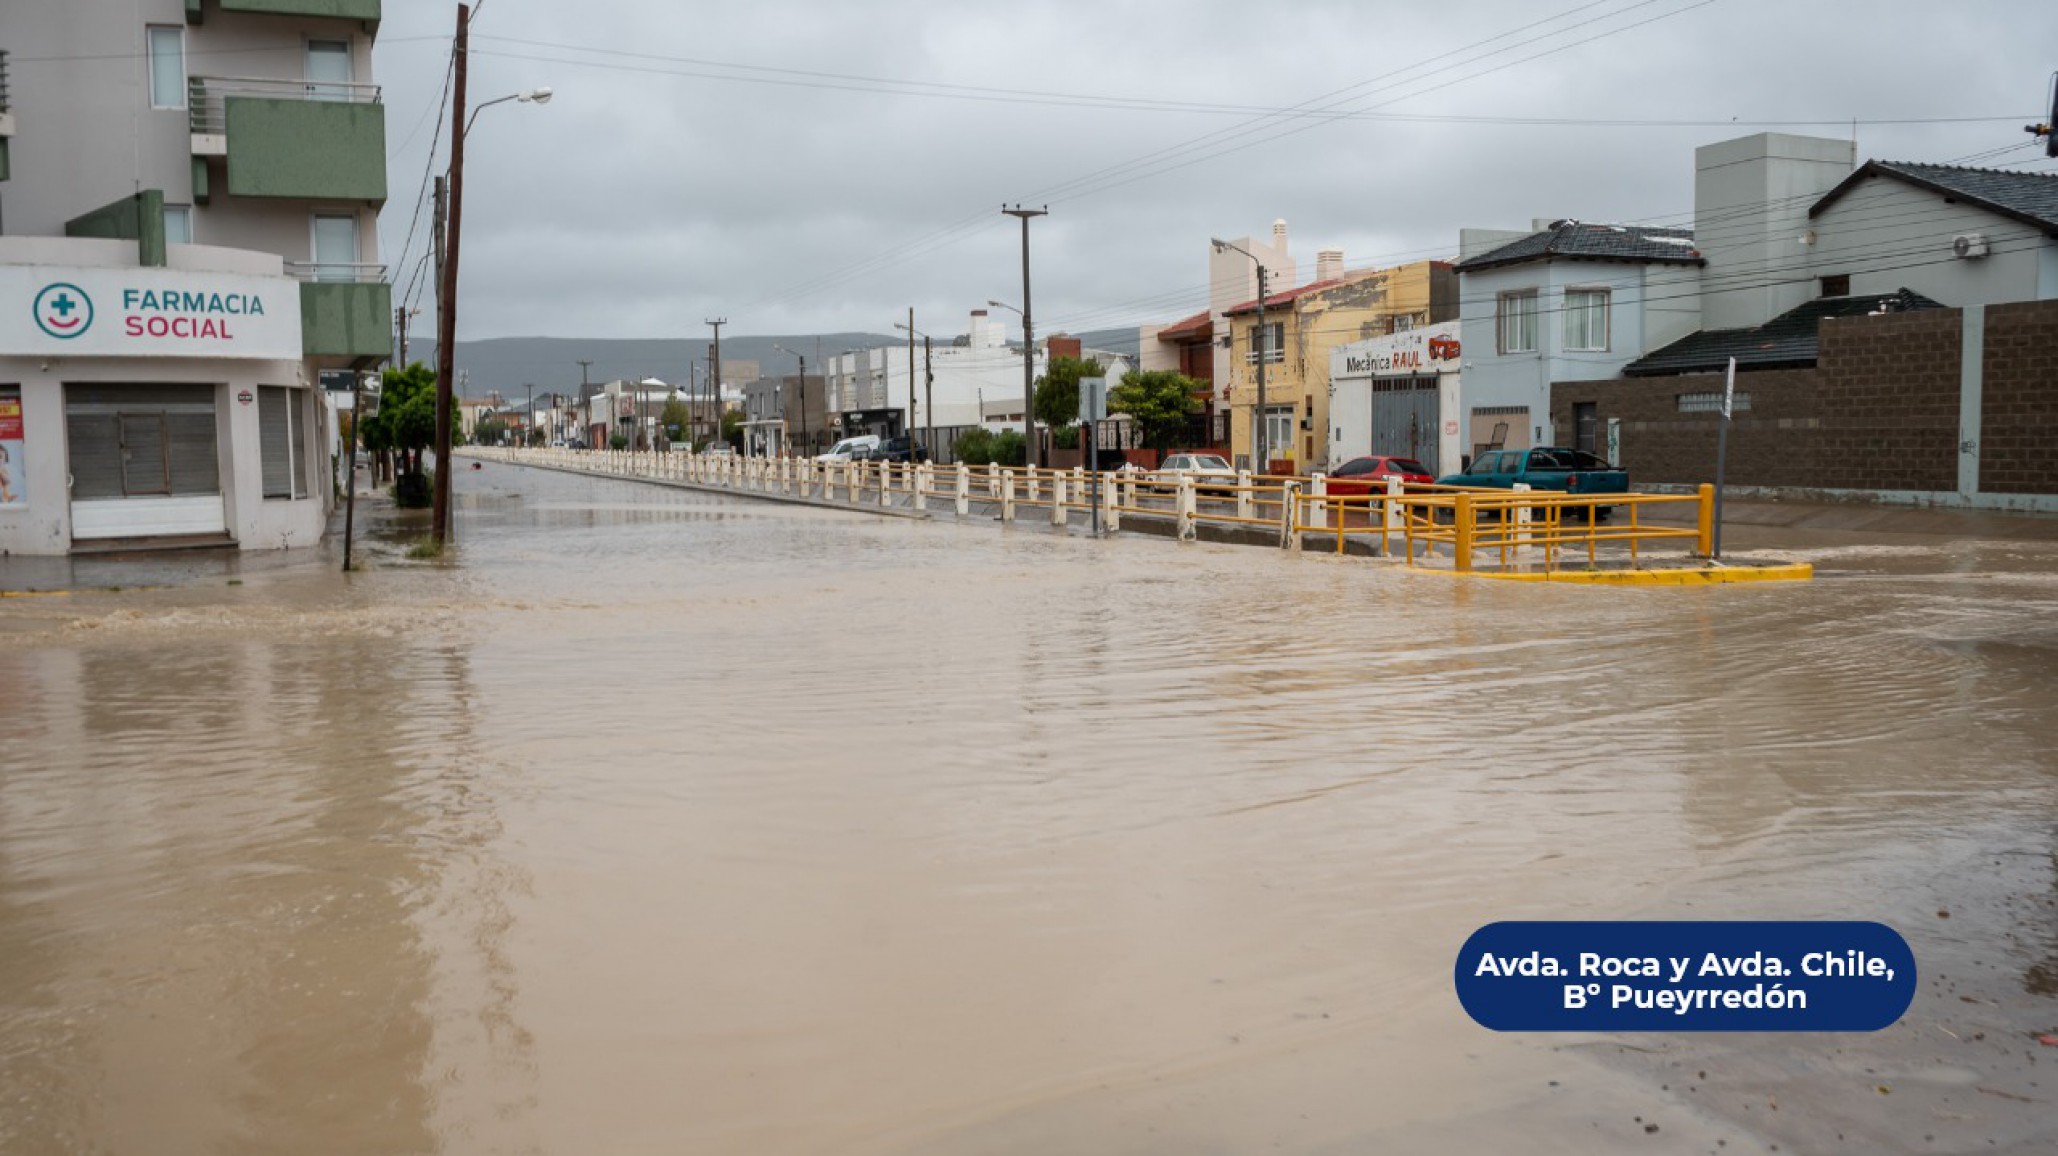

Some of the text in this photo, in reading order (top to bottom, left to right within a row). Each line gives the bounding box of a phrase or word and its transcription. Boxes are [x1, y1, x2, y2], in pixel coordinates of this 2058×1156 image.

[123, 289, 264, 316] FARMACIA
[125, 315, 234, 339] SOCIAL
[1391, 350, 1423, 370] RAUL
